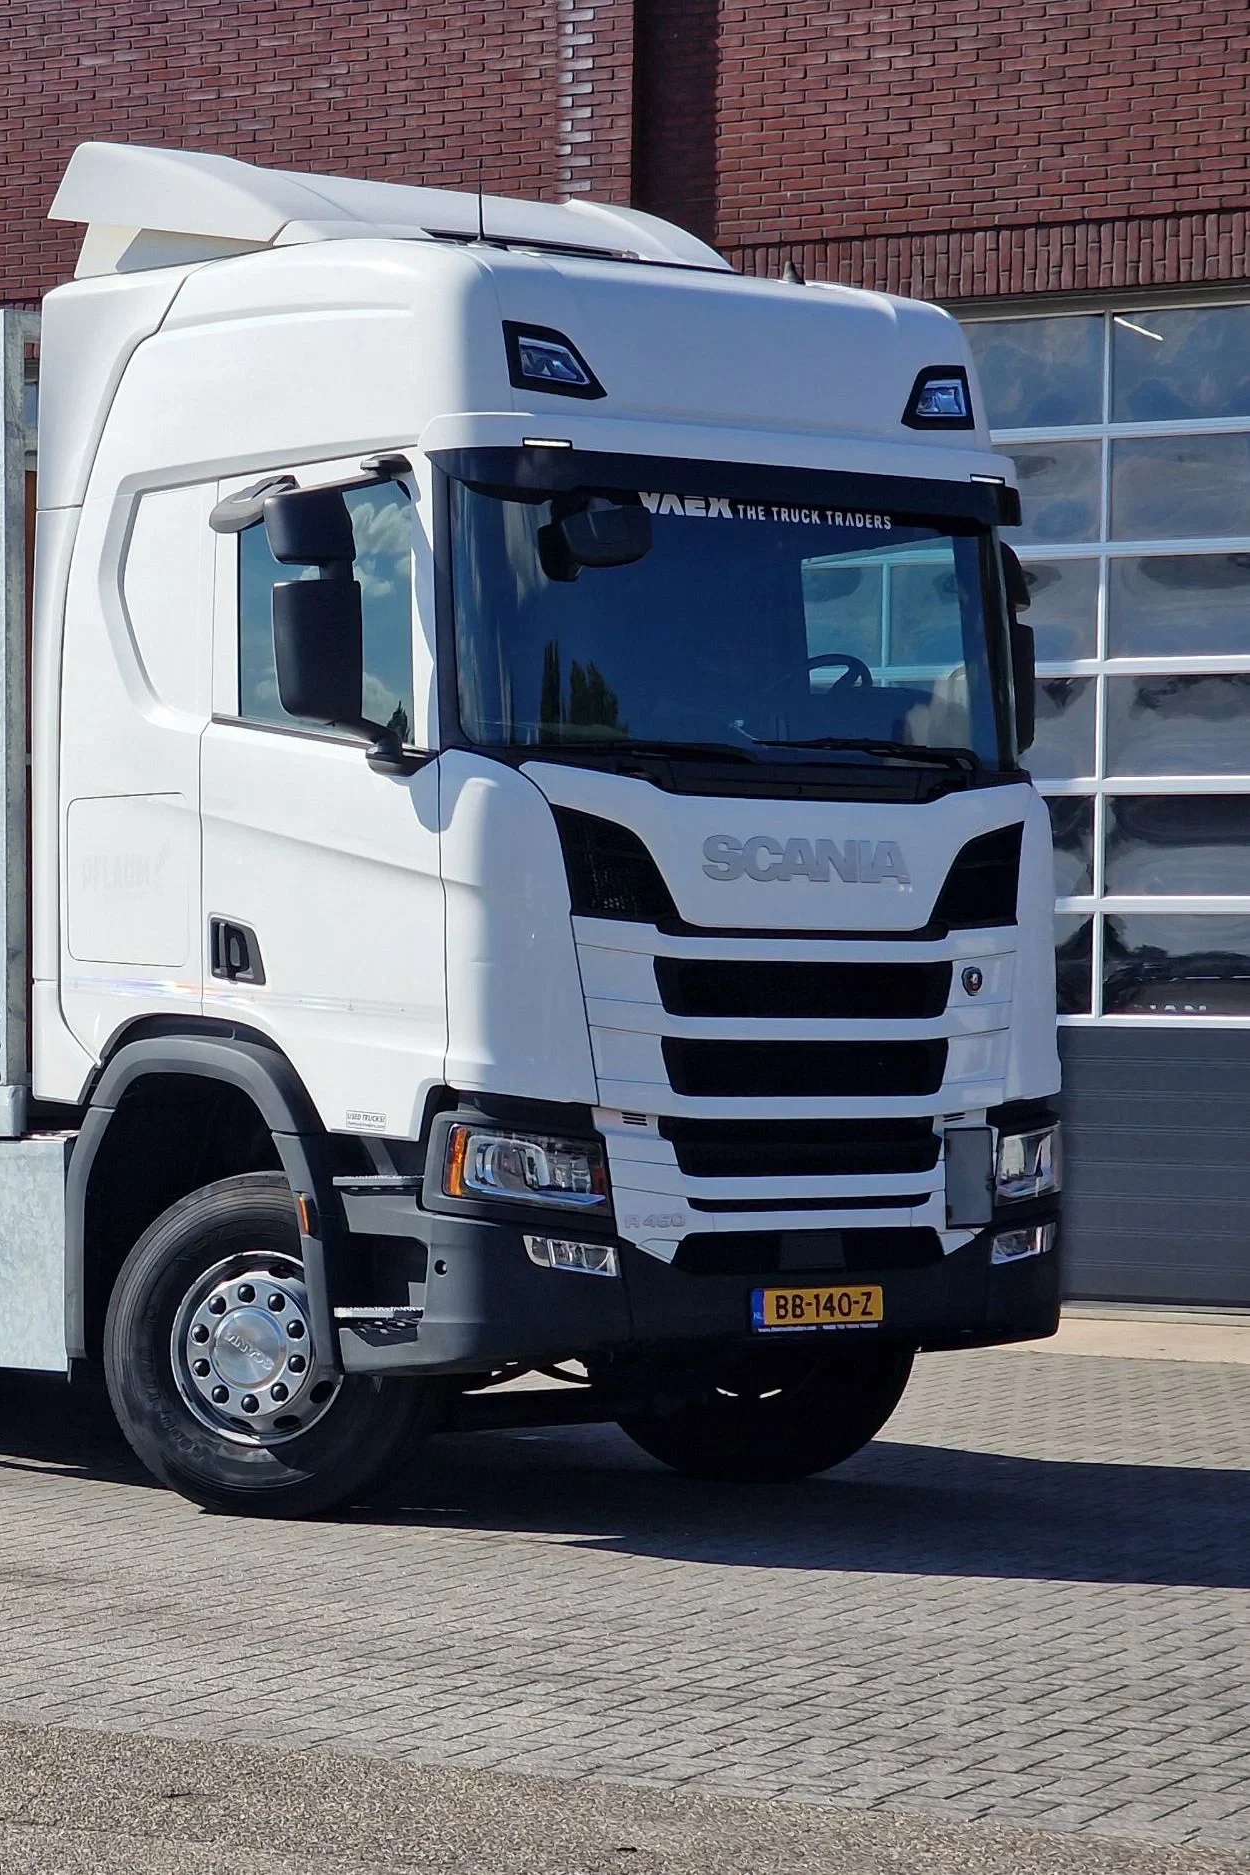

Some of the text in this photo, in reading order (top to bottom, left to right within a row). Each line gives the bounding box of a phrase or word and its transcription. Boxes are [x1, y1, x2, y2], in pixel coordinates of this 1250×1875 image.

[737, 504, 766, 521] THE
[771, 507, 821, 525] TRUCK
[825, 511, 892, 530] TRADERS
[701, 834, 911, 884] SCANIA
[774, 1291, 874, 1320] BB-140-Z
